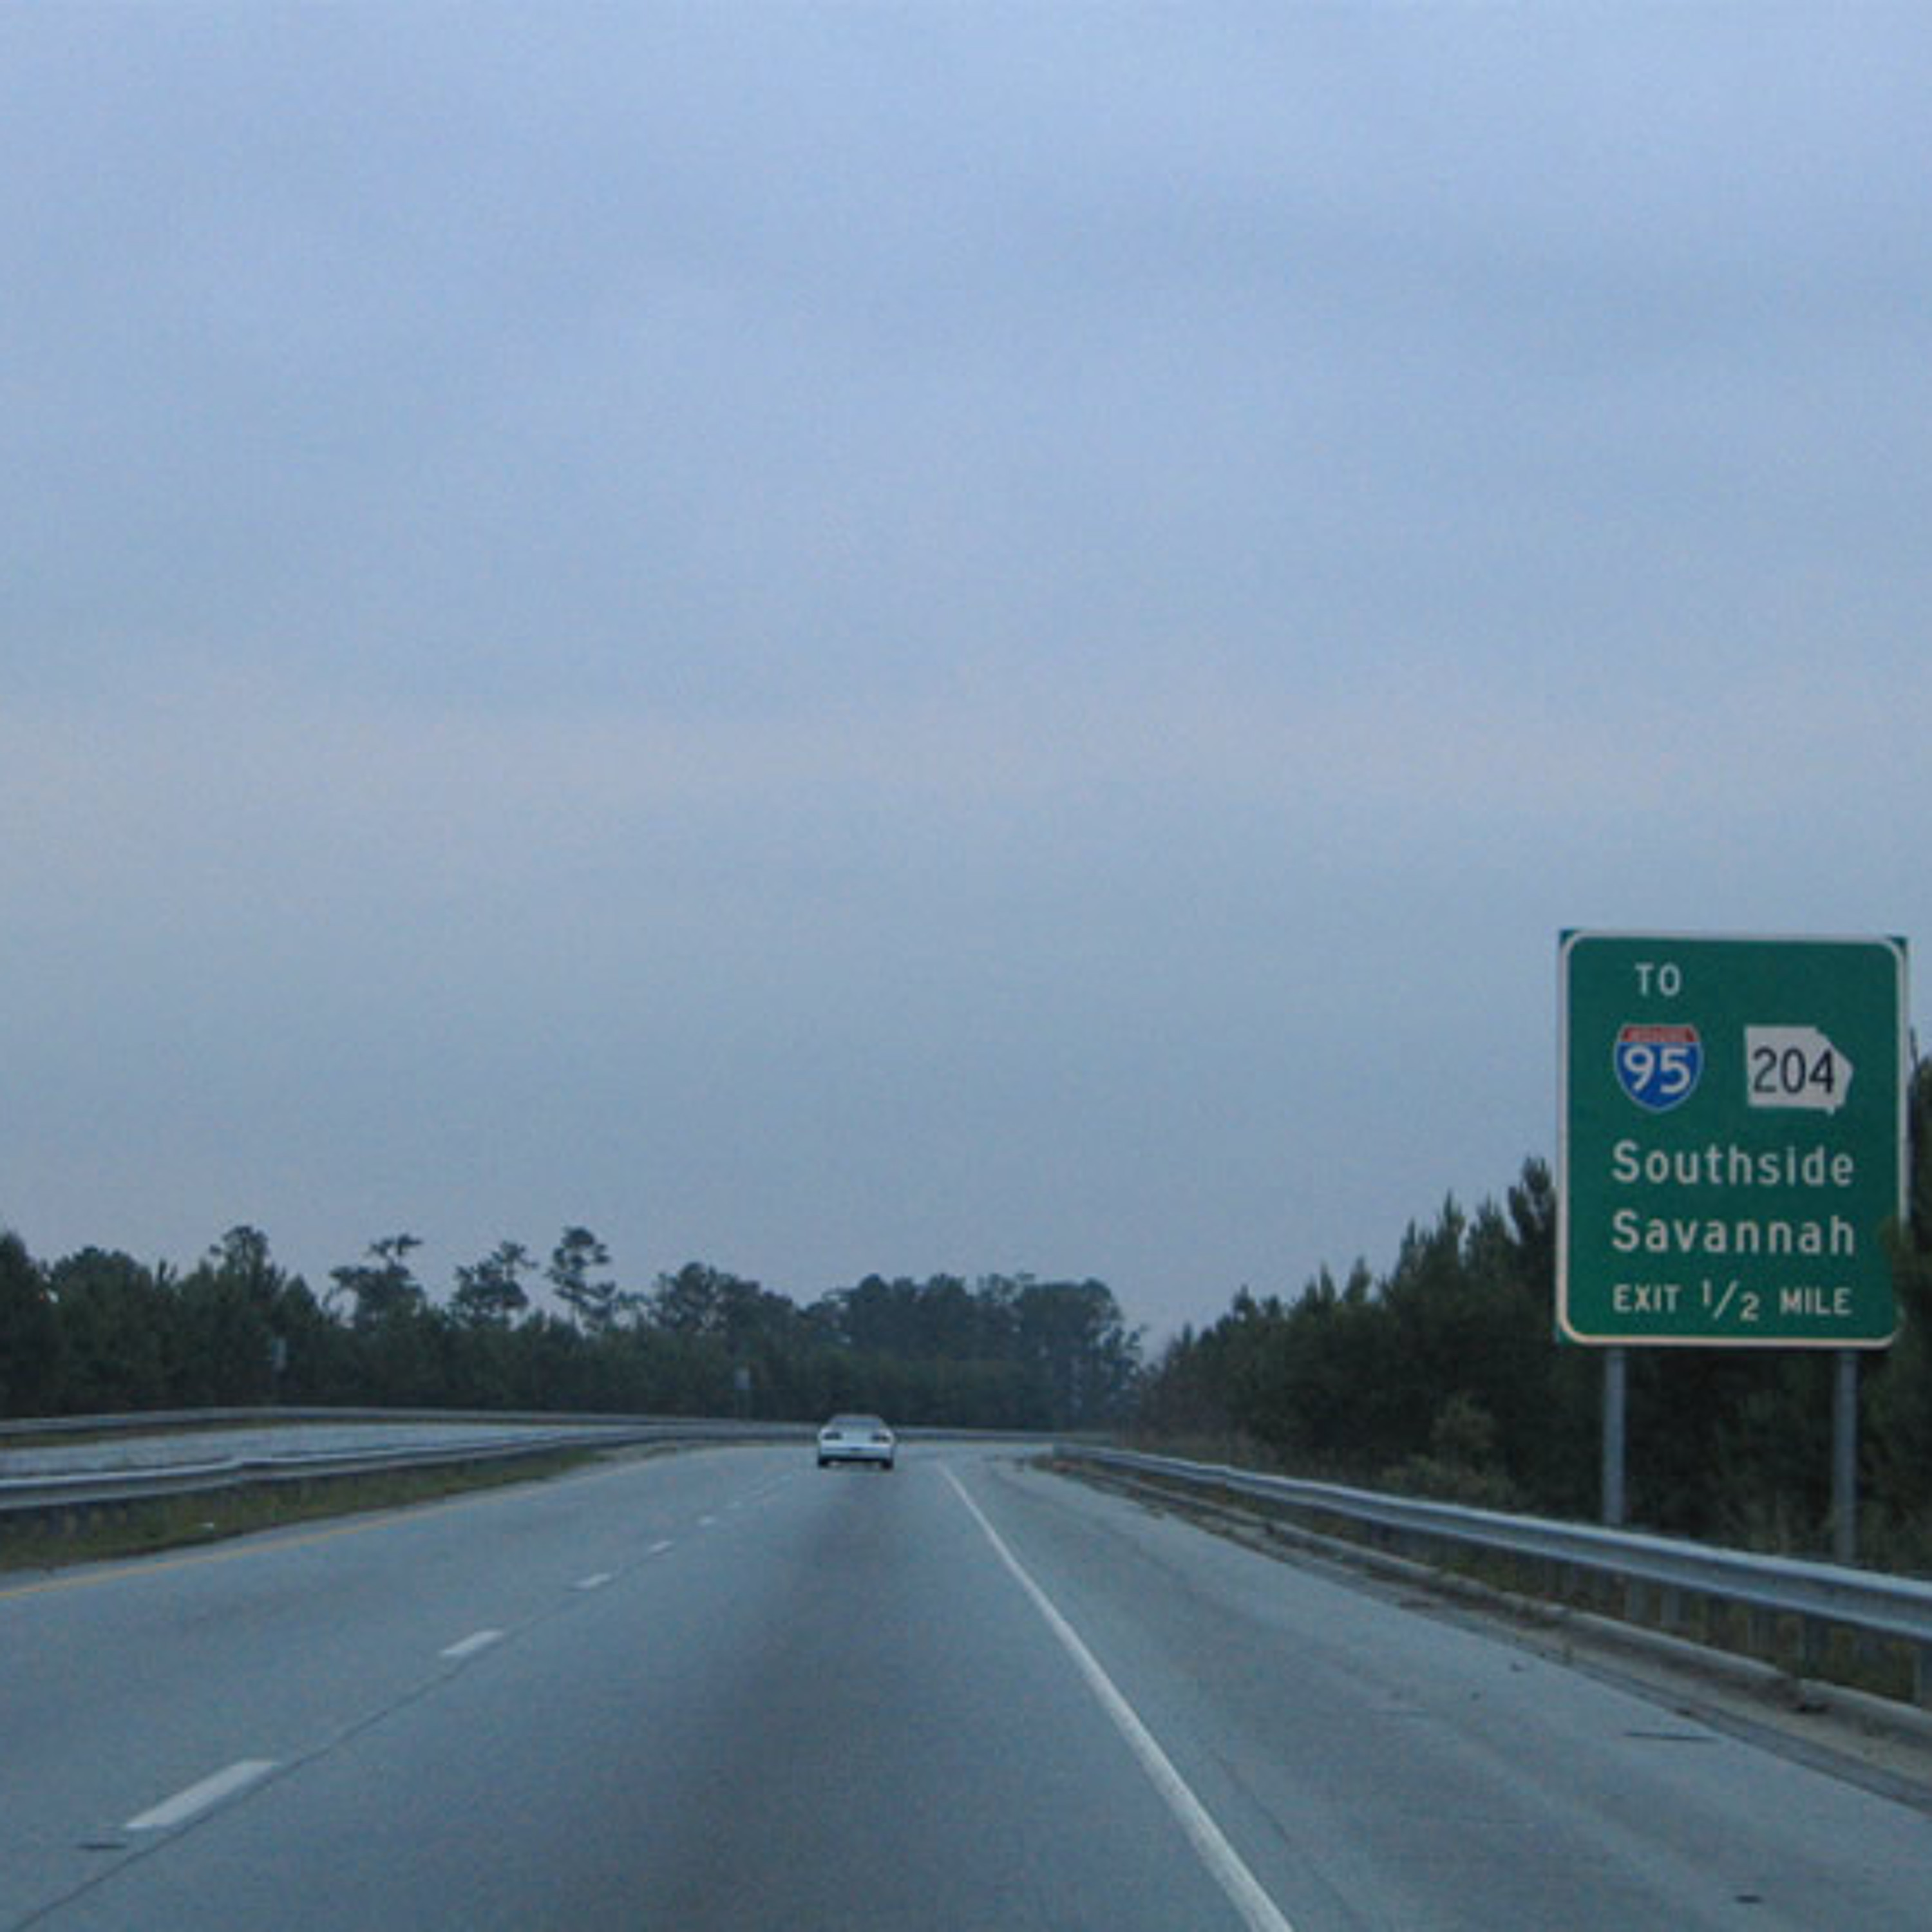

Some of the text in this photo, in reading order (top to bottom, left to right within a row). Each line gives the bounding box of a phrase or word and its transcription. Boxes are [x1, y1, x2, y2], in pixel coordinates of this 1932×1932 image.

[1635, 963, 1681, 997] TO
[1623, 1045, 1690, 1094] 95
[1752, 1047, 1835, 1095] 204
[1612, 1139, 1855, 1187] Southside
[1612, 1209, 1855, 1256] Savannah
[1613, 1283, 1681, 1313] EXIT
[1780, 1287, 1852, 1315] MILE
